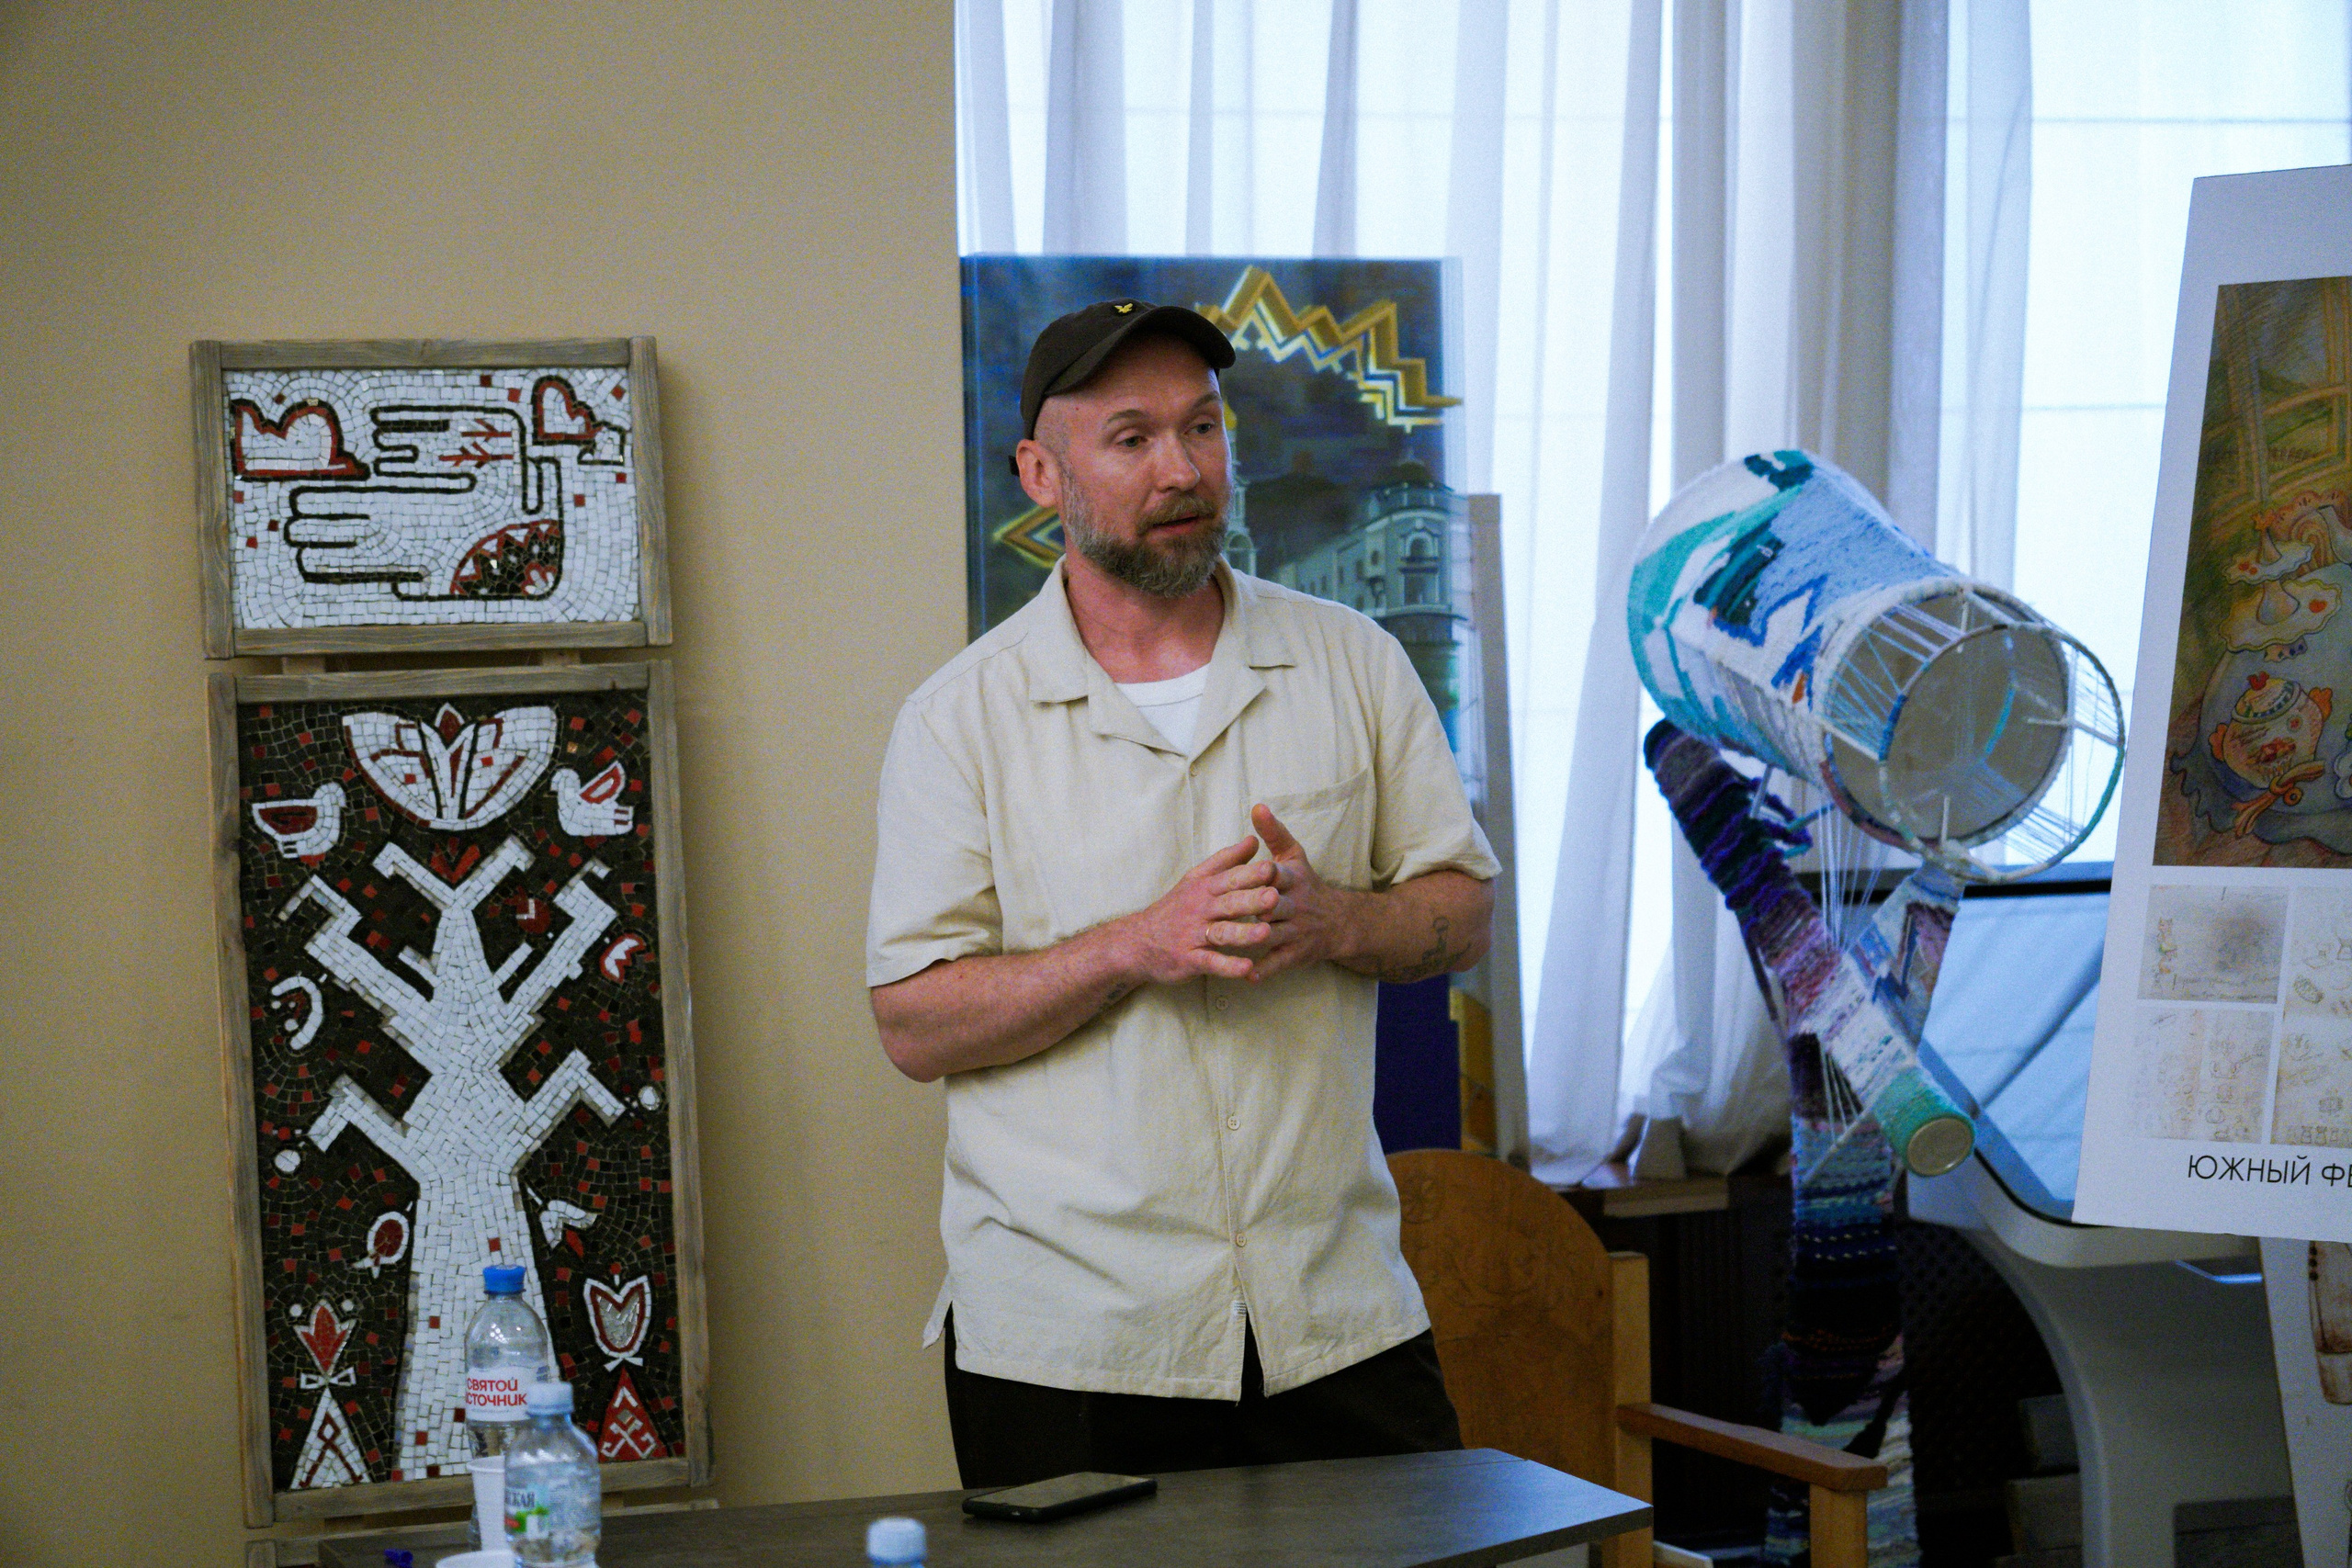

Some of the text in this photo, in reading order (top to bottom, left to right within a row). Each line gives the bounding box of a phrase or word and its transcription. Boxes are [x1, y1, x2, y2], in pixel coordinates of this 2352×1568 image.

[2188, 1154, 2311, 1185] ЮЖНЫЙ
[467, 1377, 518, 1392] СВЯТОЙ
[465, 1392, 527, 1406] СТОЧНИК
